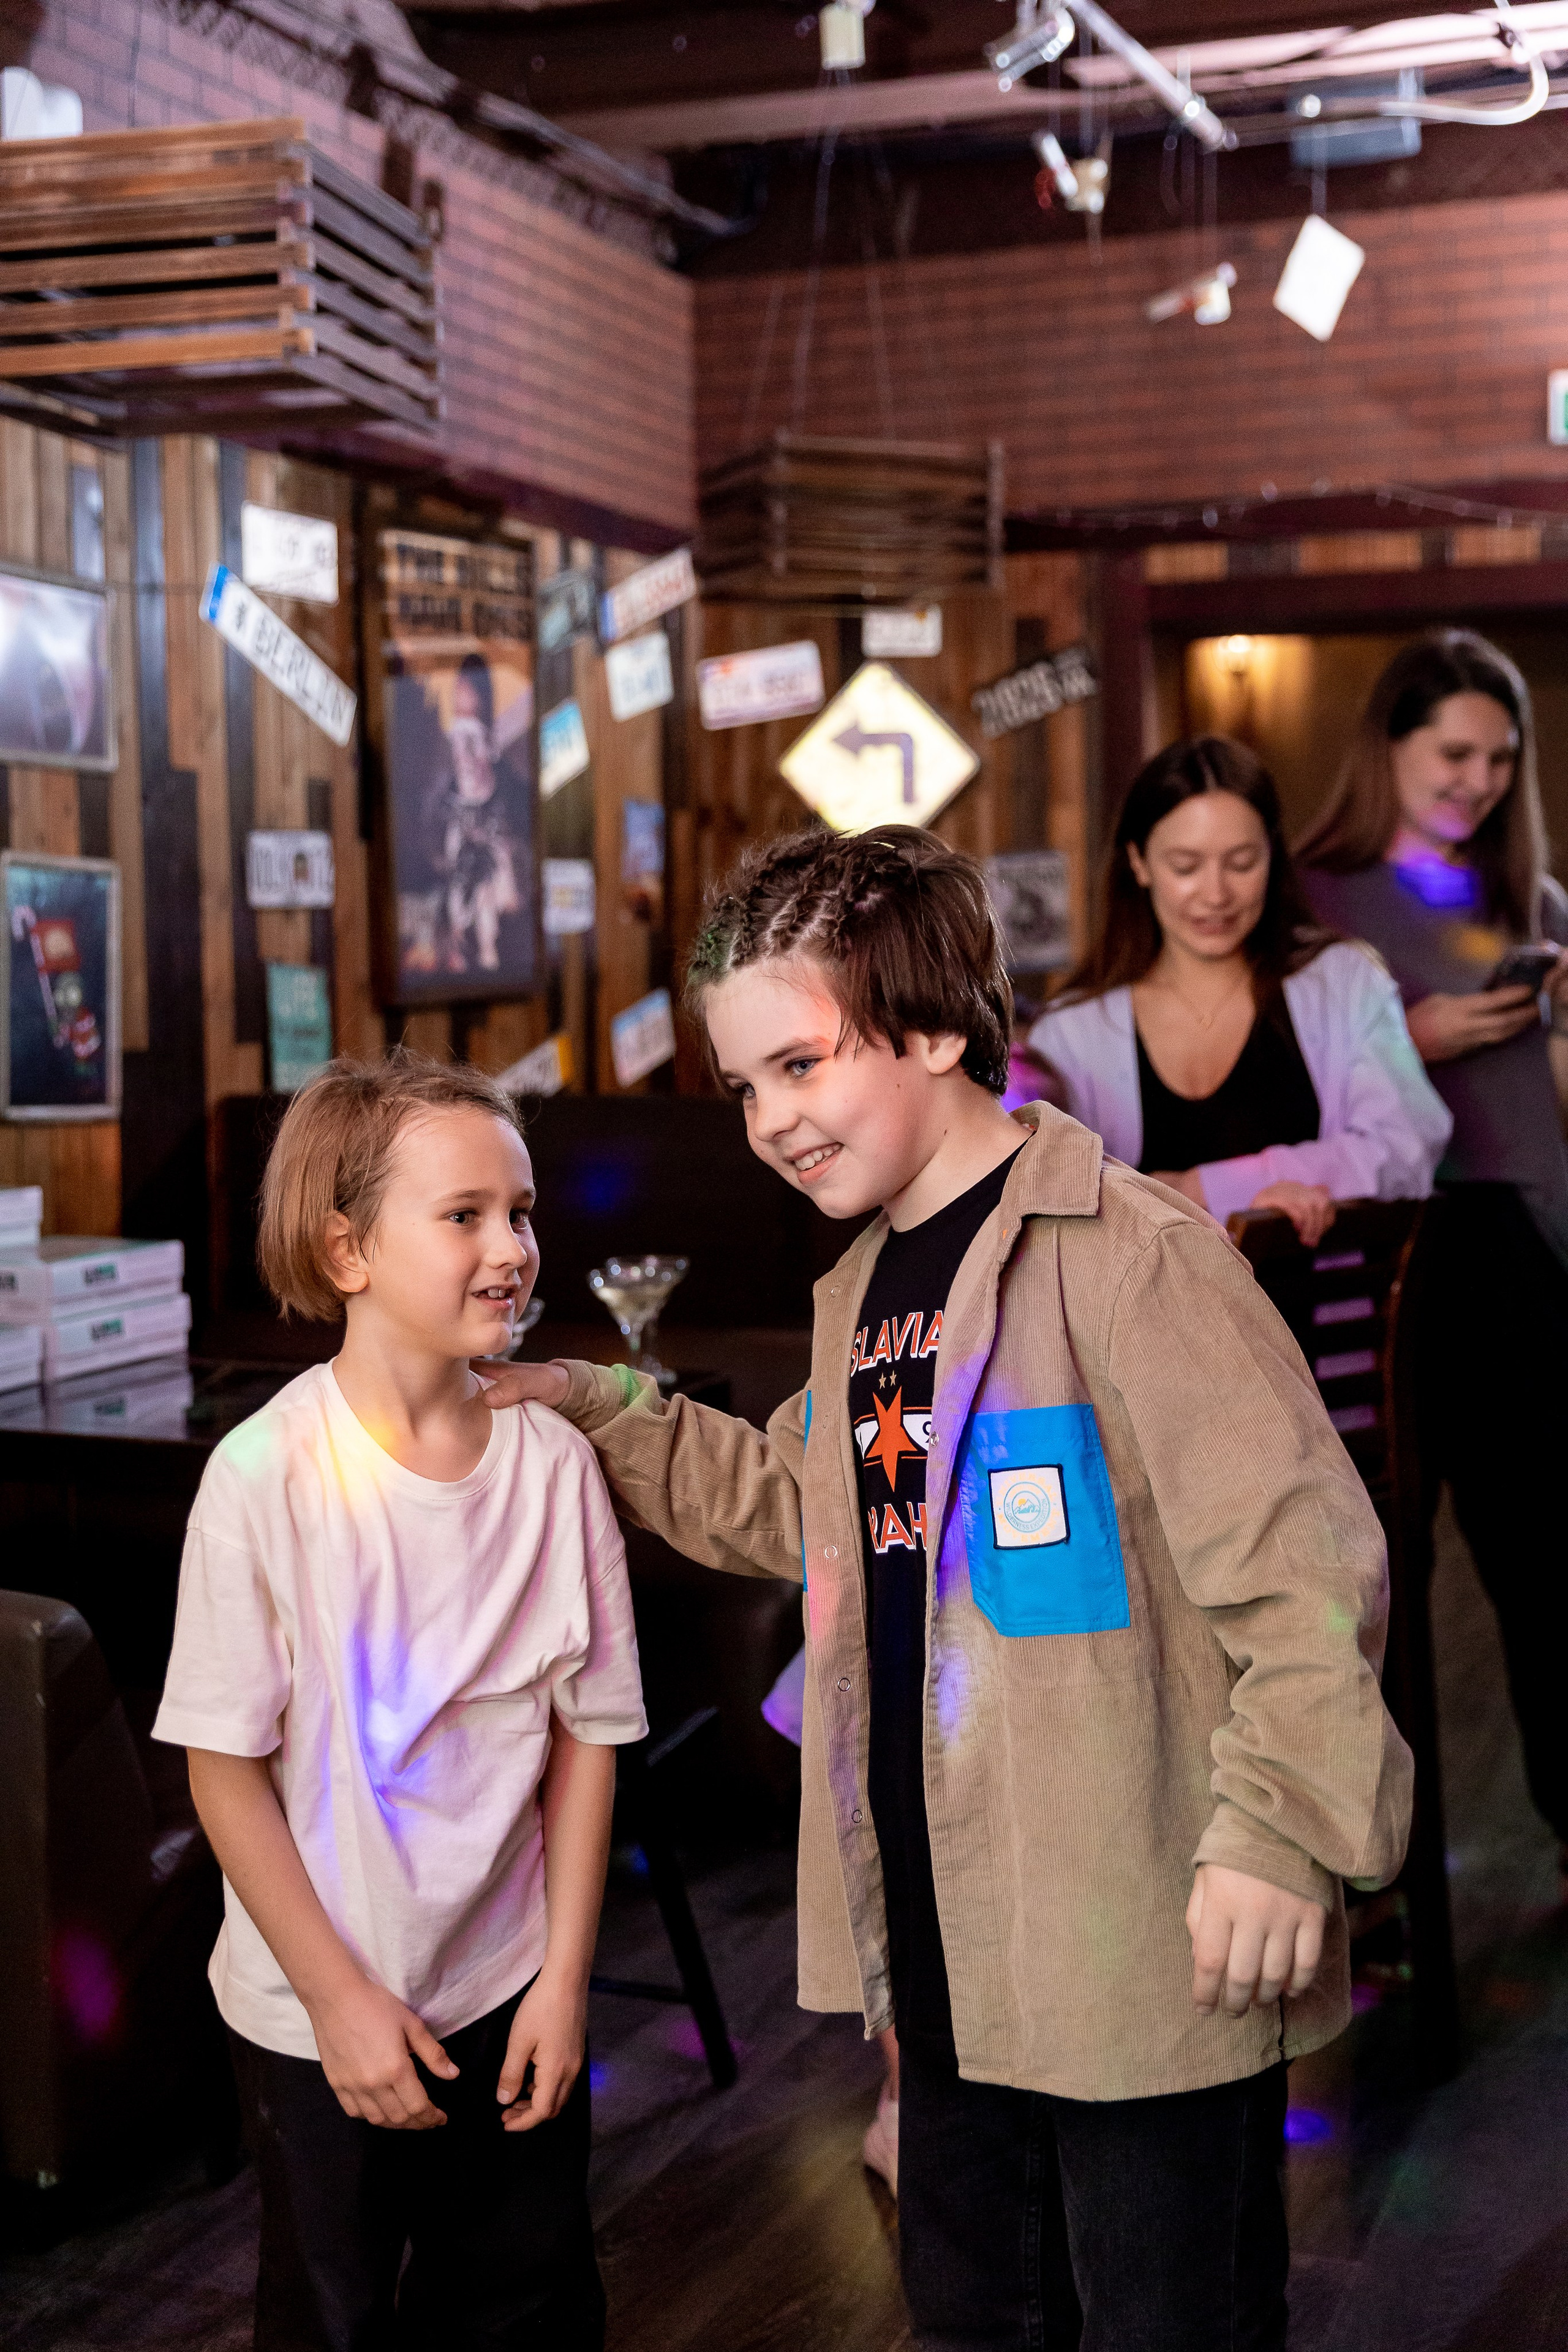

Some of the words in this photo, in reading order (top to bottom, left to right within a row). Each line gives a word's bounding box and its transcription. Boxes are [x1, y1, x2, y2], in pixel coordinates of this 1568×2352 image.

[851, 1310, 943, 1377] SLAVIA
[1006, 1502, 1030, 1530] WILDERNESS
[1030, 1498, 1048, 1529] EXPEDITION
